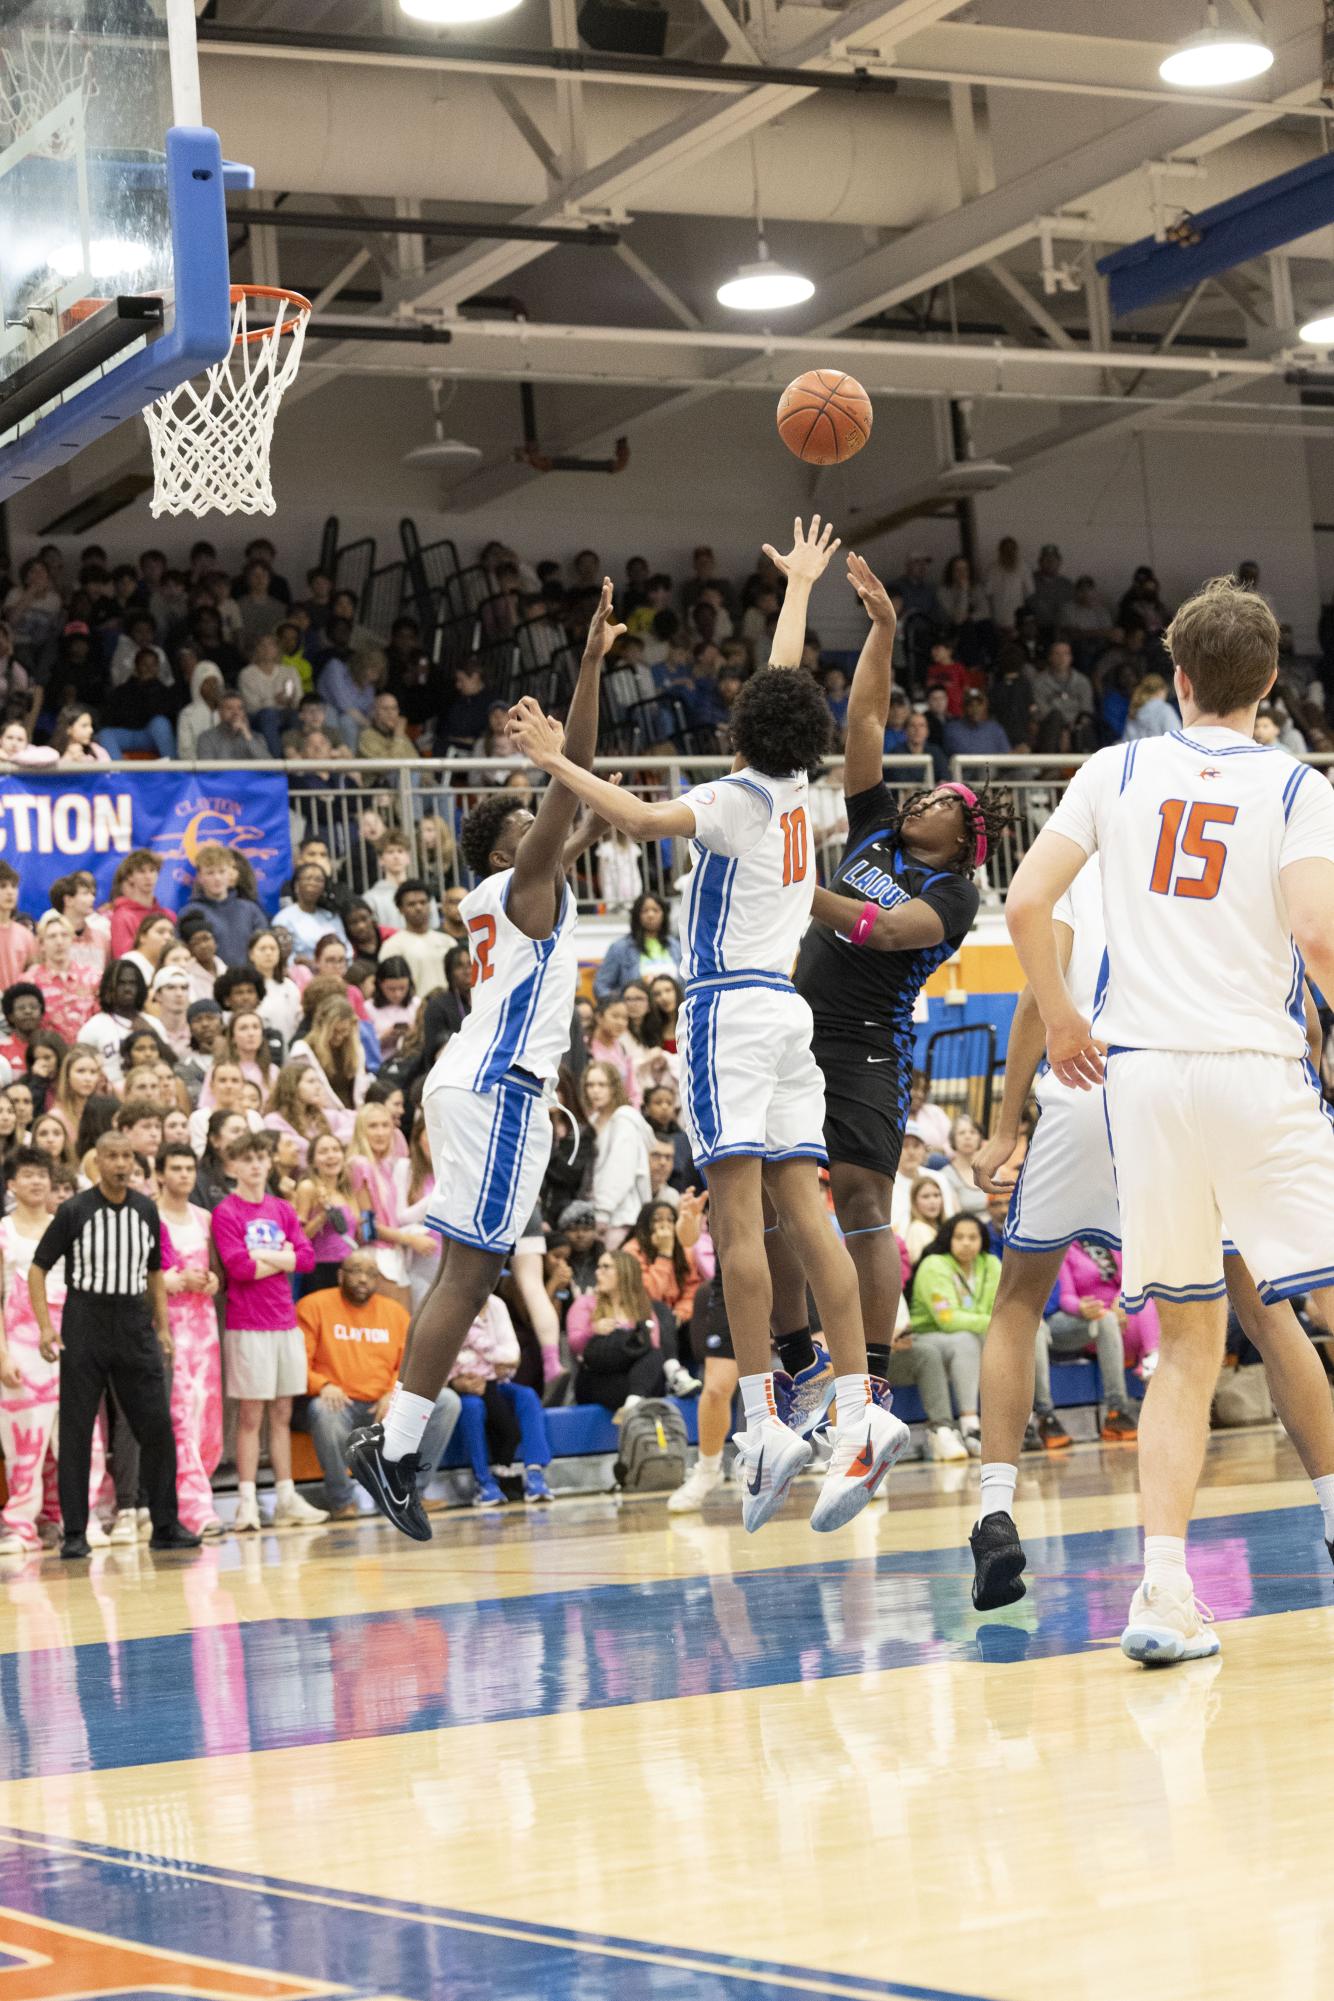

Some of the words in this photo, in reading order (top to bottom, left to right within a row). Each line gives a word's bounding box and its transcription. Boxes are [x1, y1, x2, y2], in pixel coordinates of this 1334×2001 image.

[0, 793, 133, 855] TION
[780, 806, 807, 887] 10
[1149, 798, 1239, 900] 15
[467, 913, 497, 988] 2
[333, 1323, 390, 1344] CLAYTON
